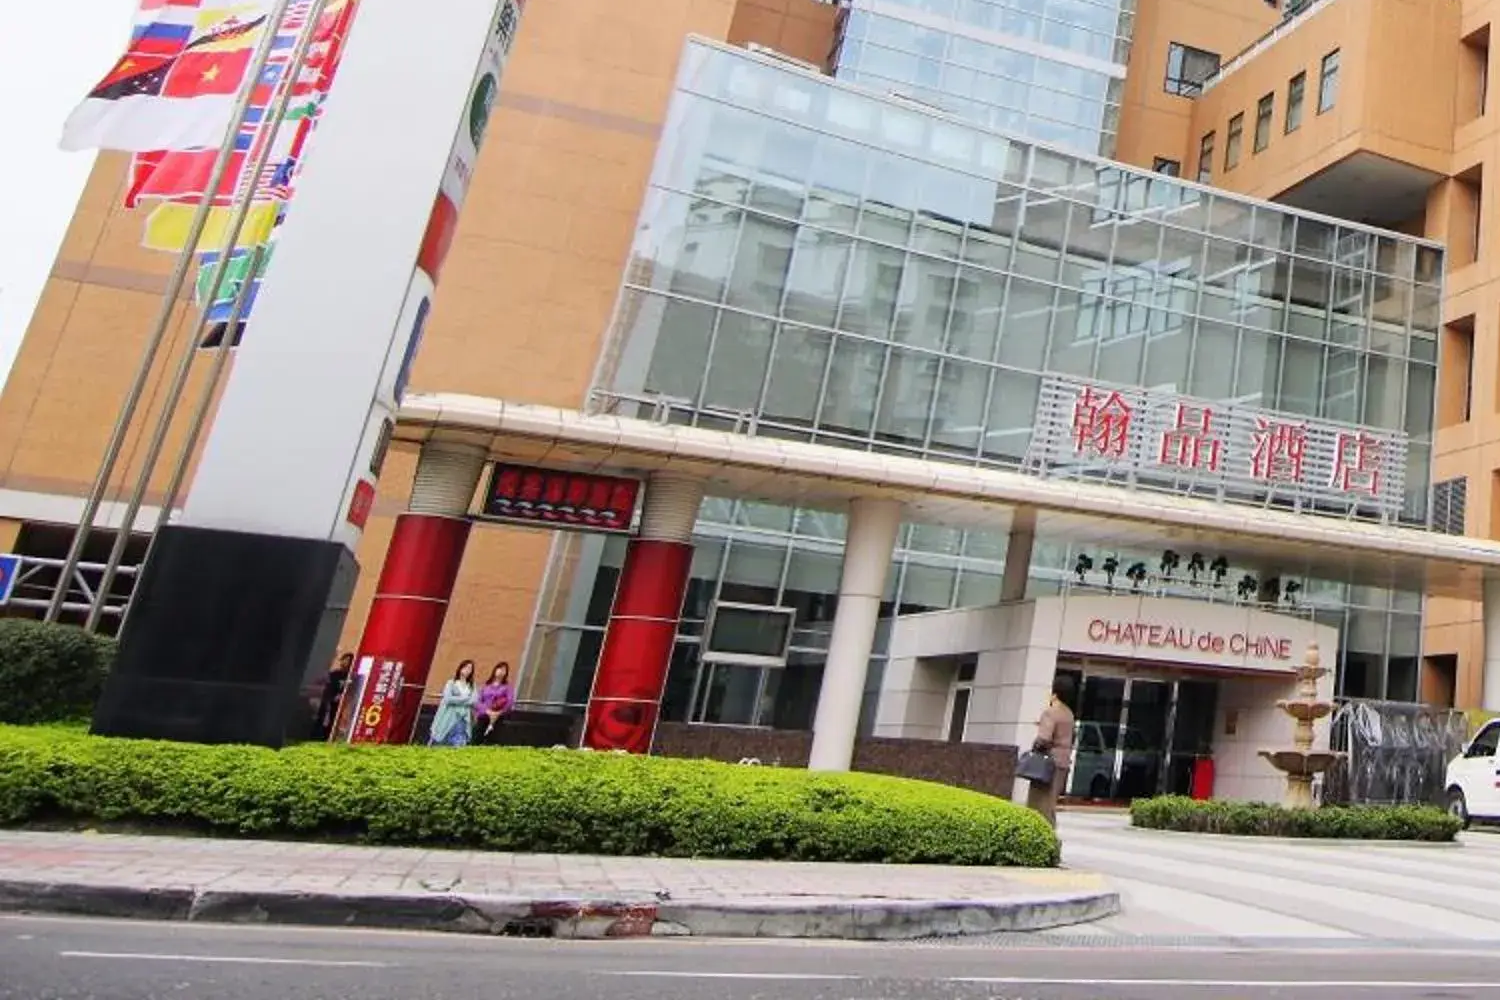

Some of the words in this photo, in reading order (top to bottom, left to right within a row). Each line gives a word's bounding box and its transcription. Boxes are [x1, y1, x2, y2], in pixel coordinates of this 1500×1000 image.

[1071, 384, 1385, 497] 翰品酒店
[1087, 618, 1194, 651] CHATEAU
[1197, 631, 1225, 654] de
